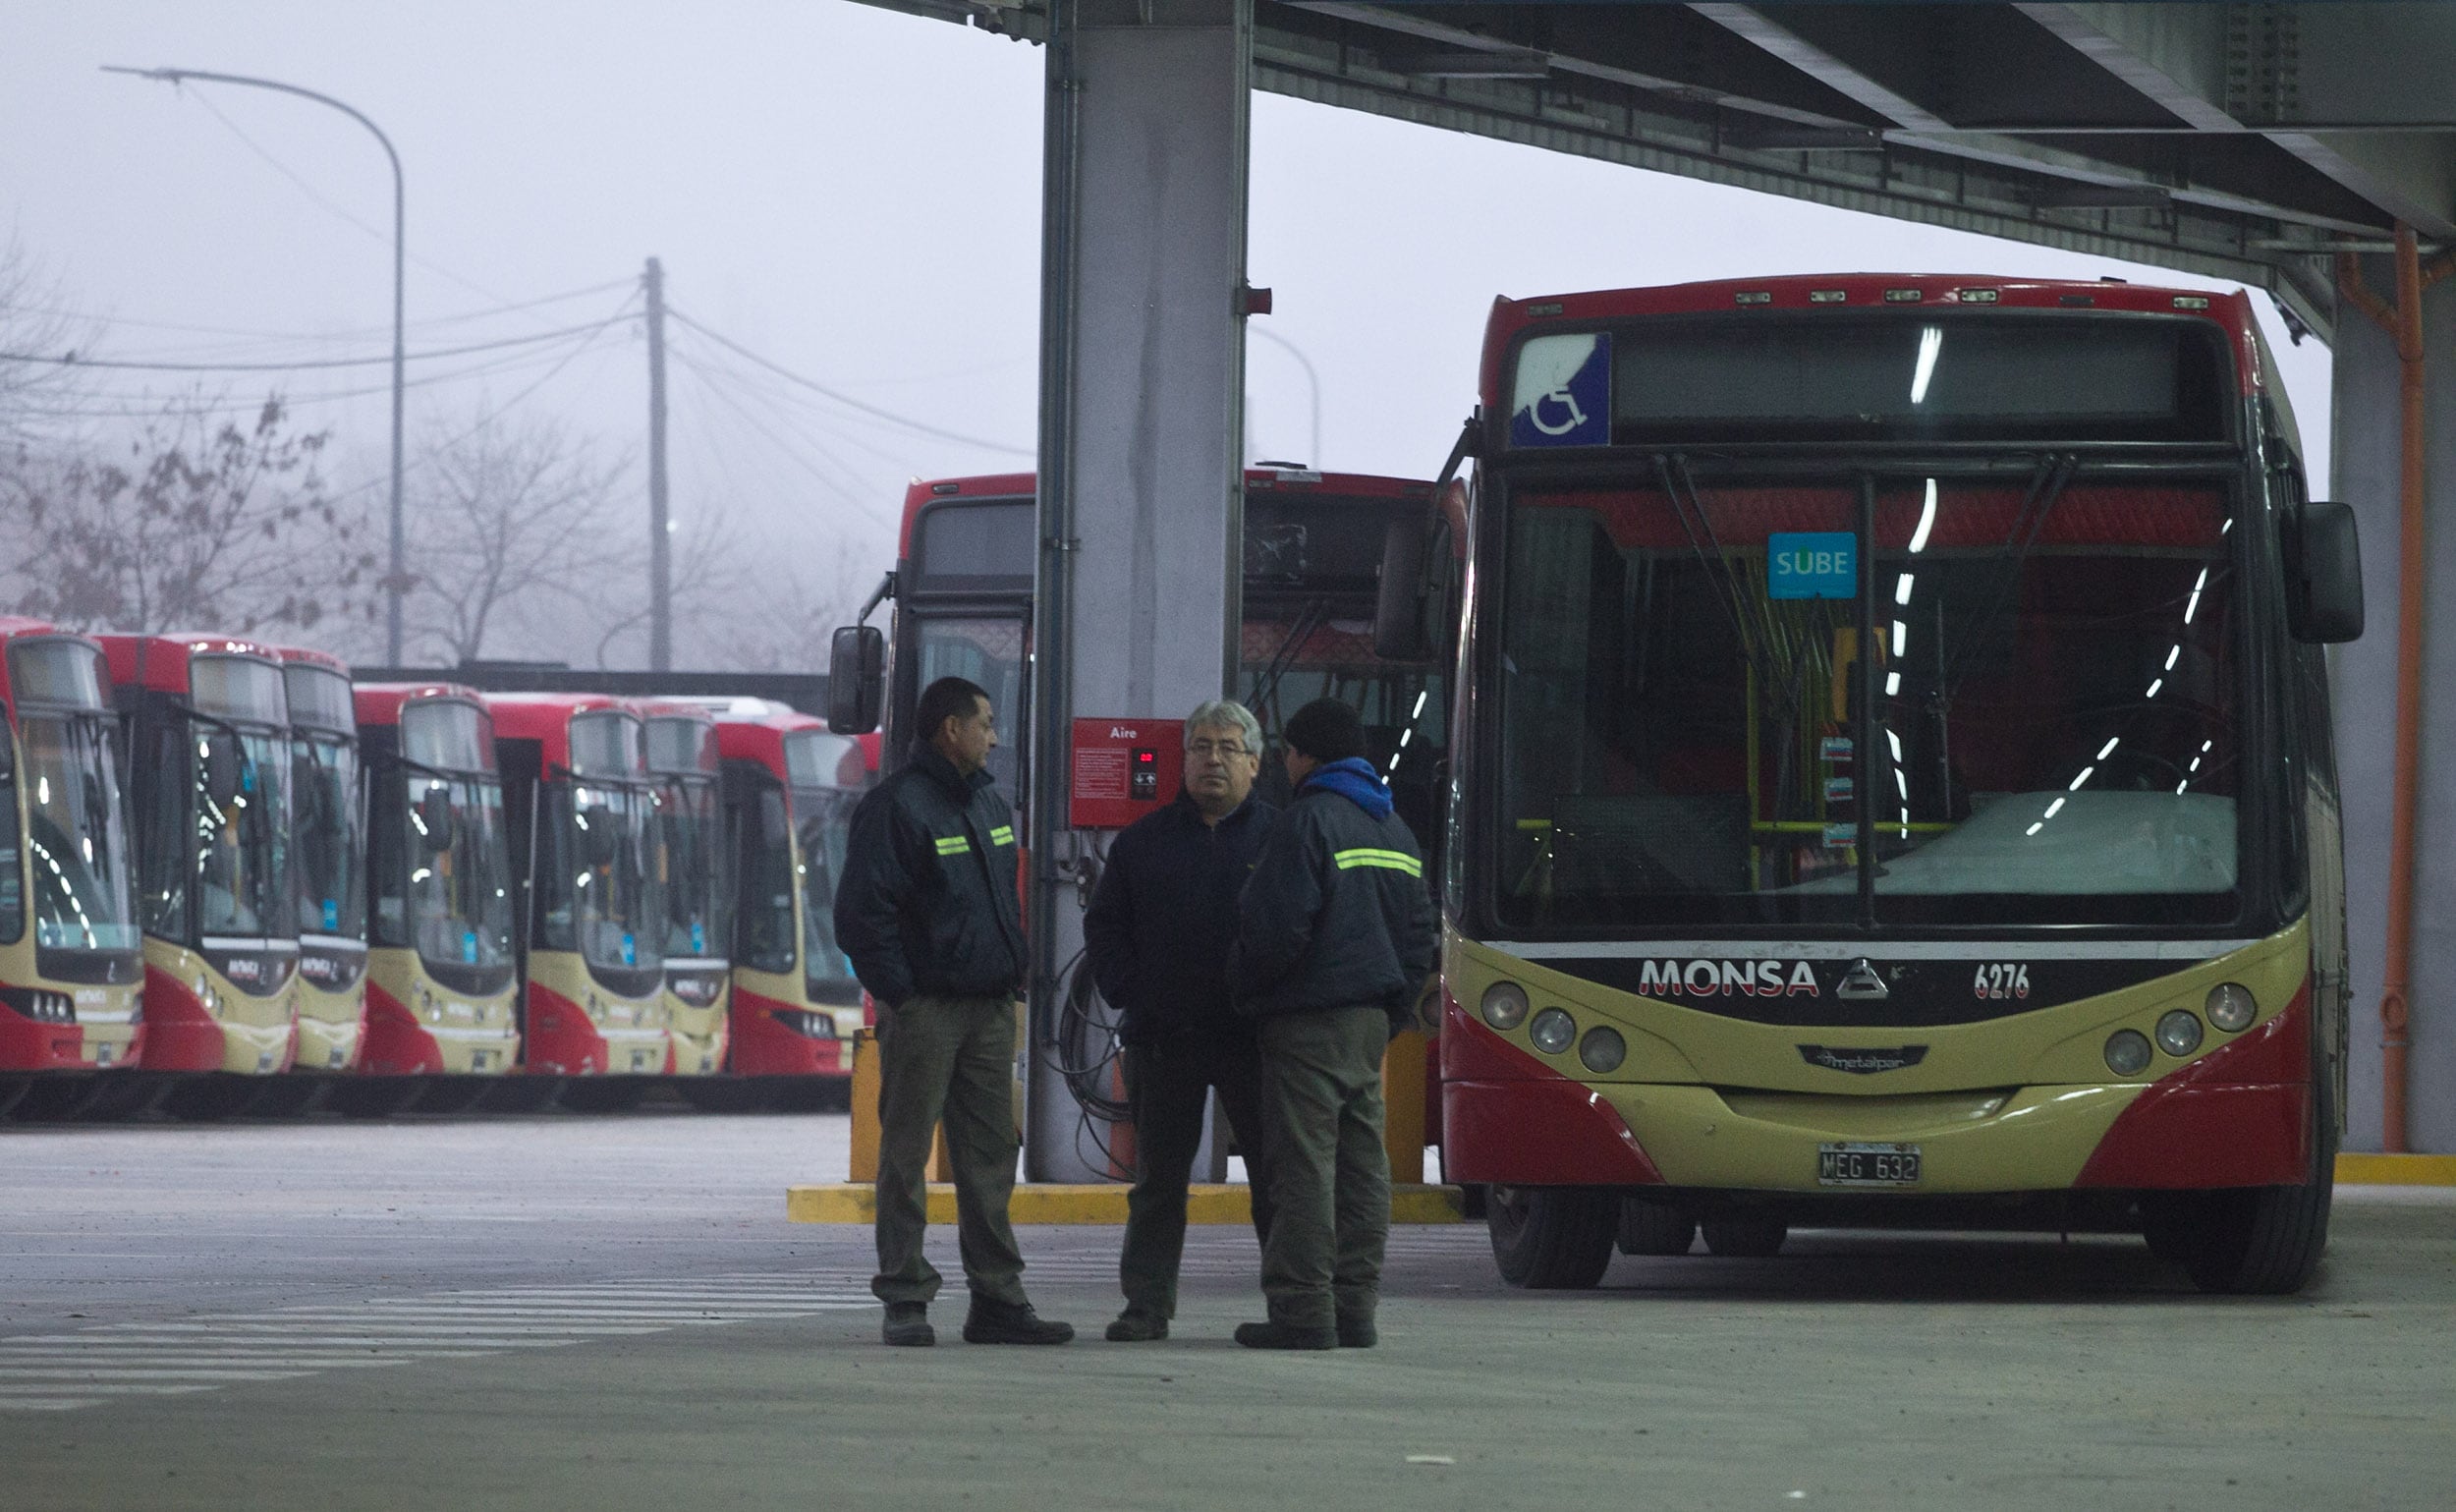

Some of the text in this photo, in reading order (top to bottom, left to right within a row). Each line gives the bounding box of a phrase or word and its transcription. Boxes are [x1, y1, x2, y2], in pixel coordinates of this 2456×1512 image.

[1776, 552, 1848, 575] SUBE
[1110, 726, 1138, 739] Aire
[1640, 960, 1819, 997] MONSA
[1974, 964, 2030, 999] 6276
[1822, 1153, 1917, 1179] MEG 632
